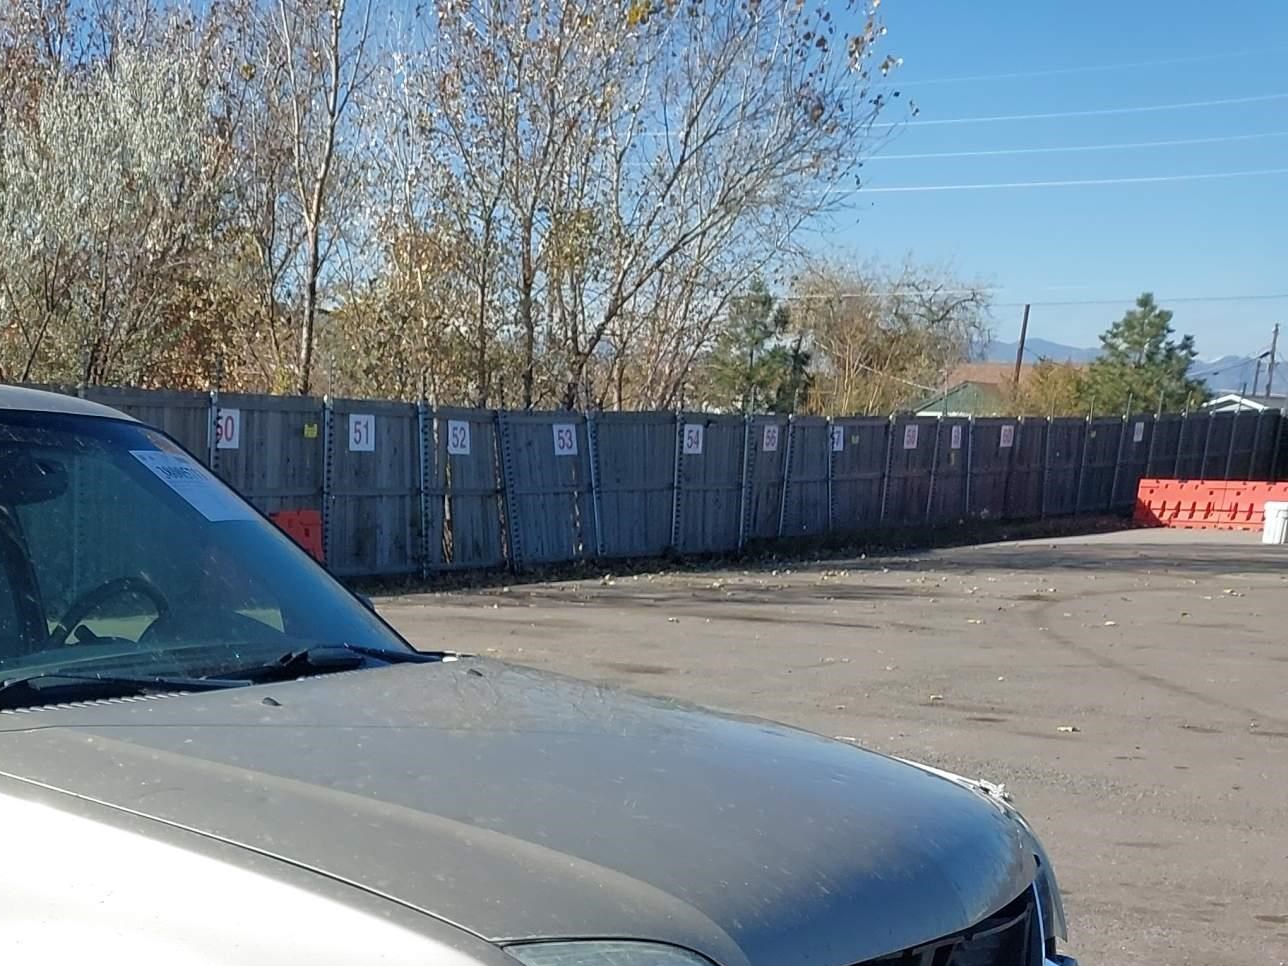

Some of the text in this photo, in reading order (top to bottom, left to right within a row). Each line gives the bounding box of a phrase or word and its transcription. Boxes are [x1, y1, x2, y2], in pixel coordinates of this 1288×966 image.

[353, 421, 369, 445] 51
[452, 426, 466, 448] 52
[557, 429, 572, 449] 53
[686, 429, 699, 449] 54
